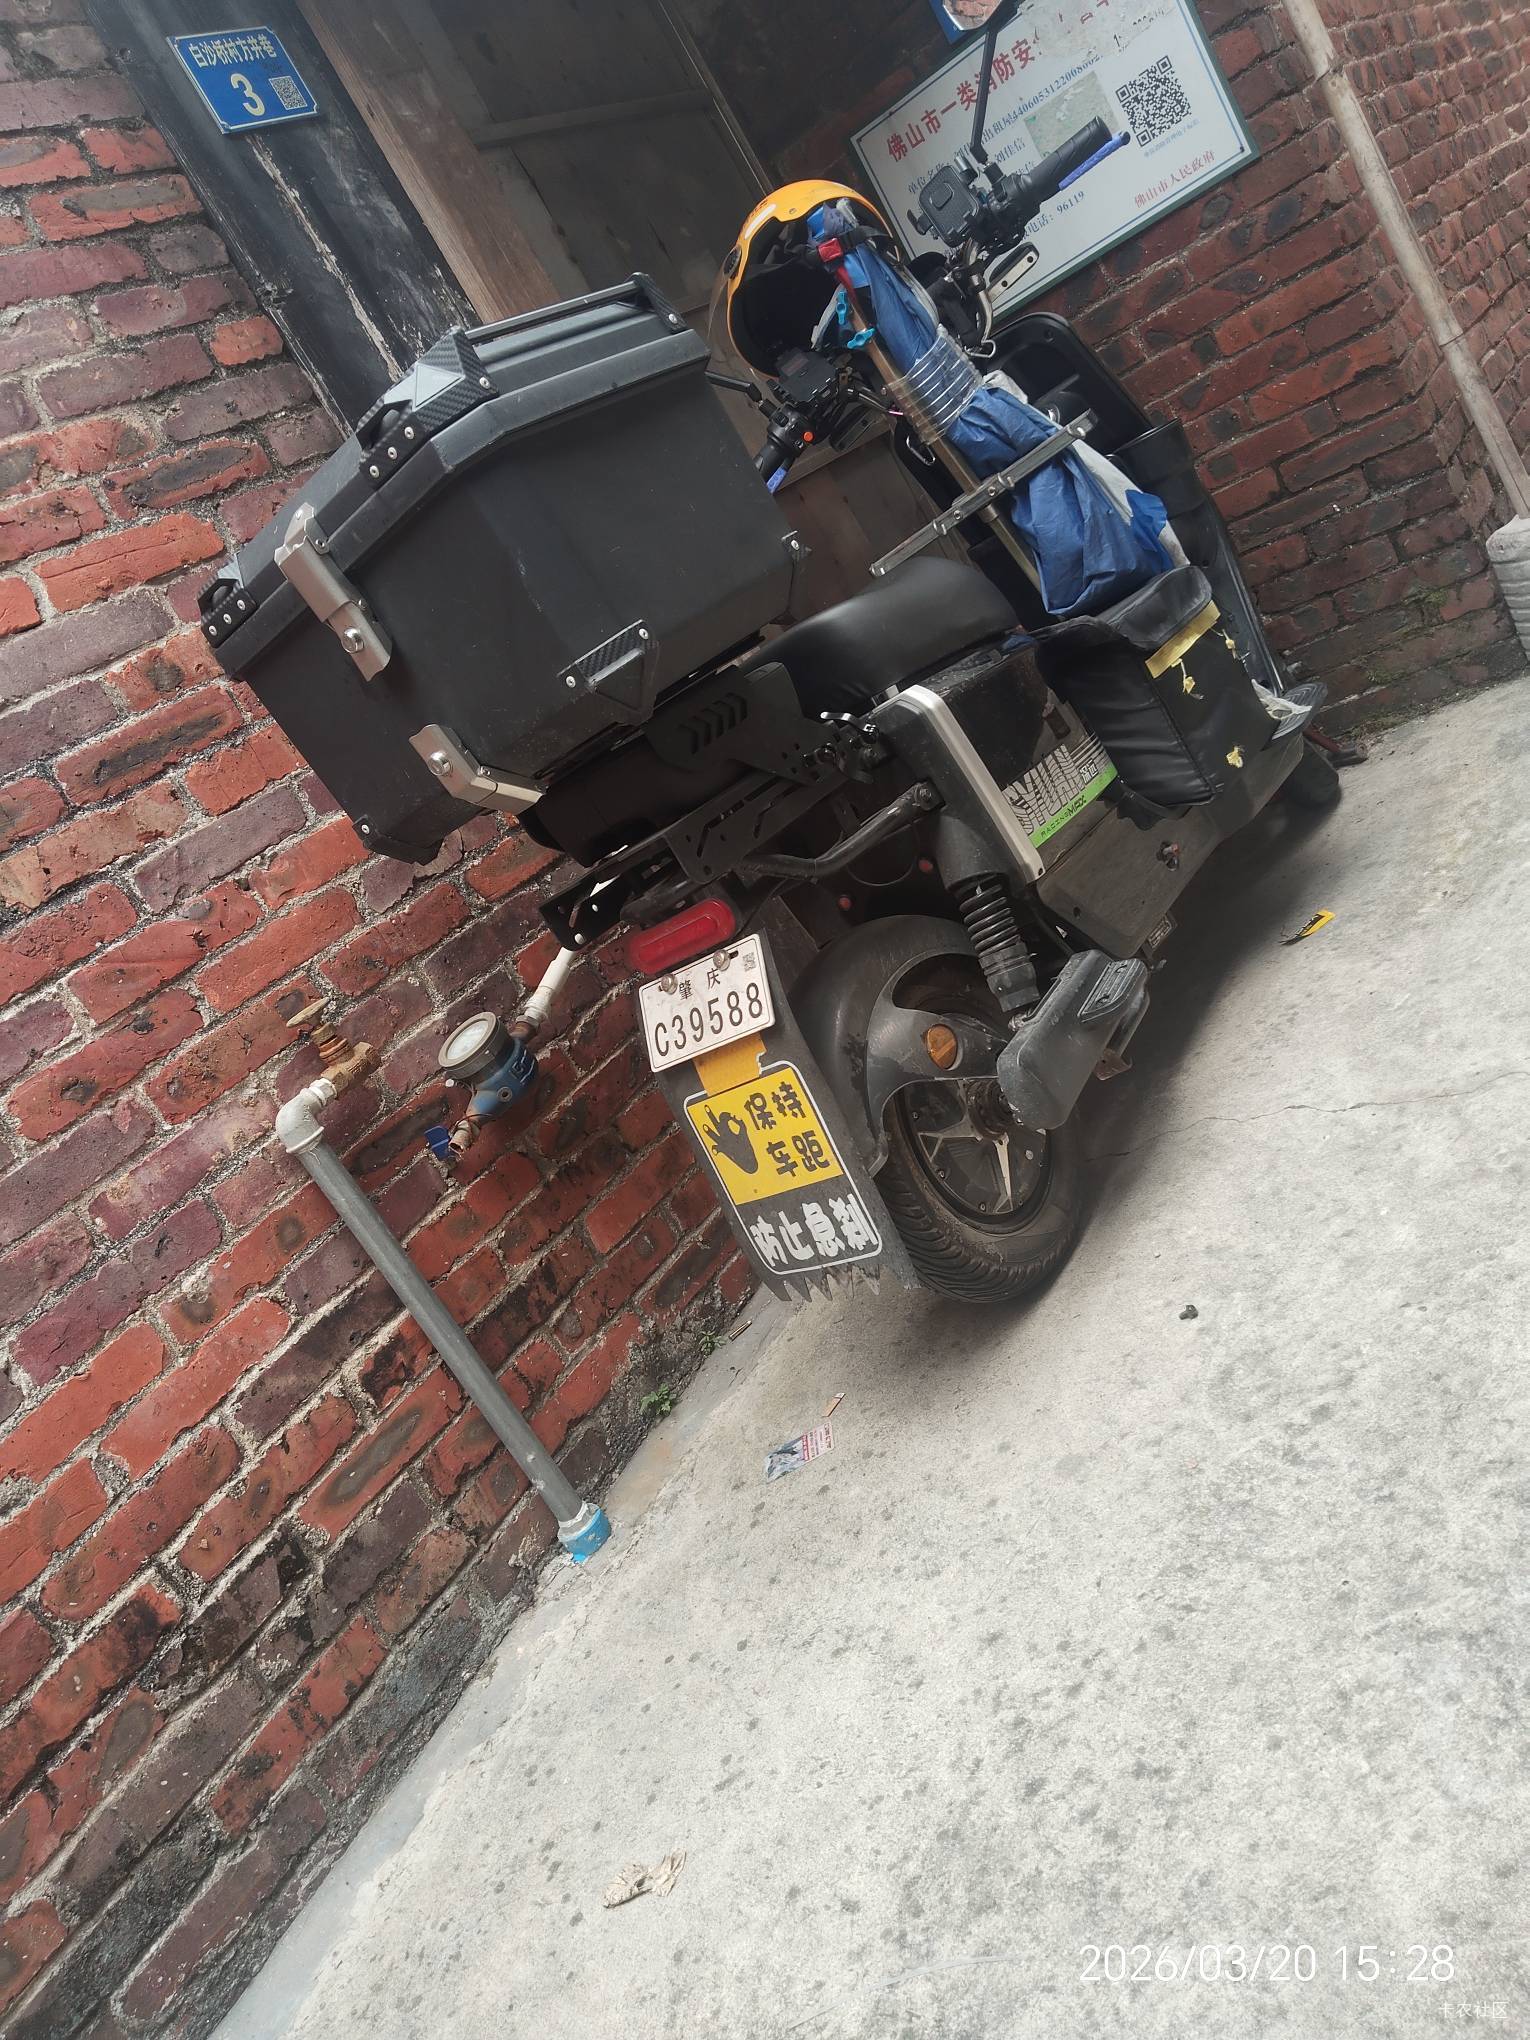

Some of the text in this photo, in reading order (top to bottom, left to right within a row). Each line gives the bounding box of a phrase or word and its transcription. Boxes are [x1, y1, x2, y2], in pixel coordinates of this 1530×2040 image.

[188, 34, 277, 68] 白沙桥村方井巷
[230, 73, 266, 116] 3
[886, 27, 1043, 163] 佛山市一类防安
[1133, 149, 1215, 208] 佛山市人民政府
[679, 967, 721, 1000] 肇庆
[655, 982, 763, 1056] C39588
[744, 1081, 806, 1132] 保持
[766, 1133, 831, 1178] 车距
[750, 1193, 878, 1268] 防止急刹
